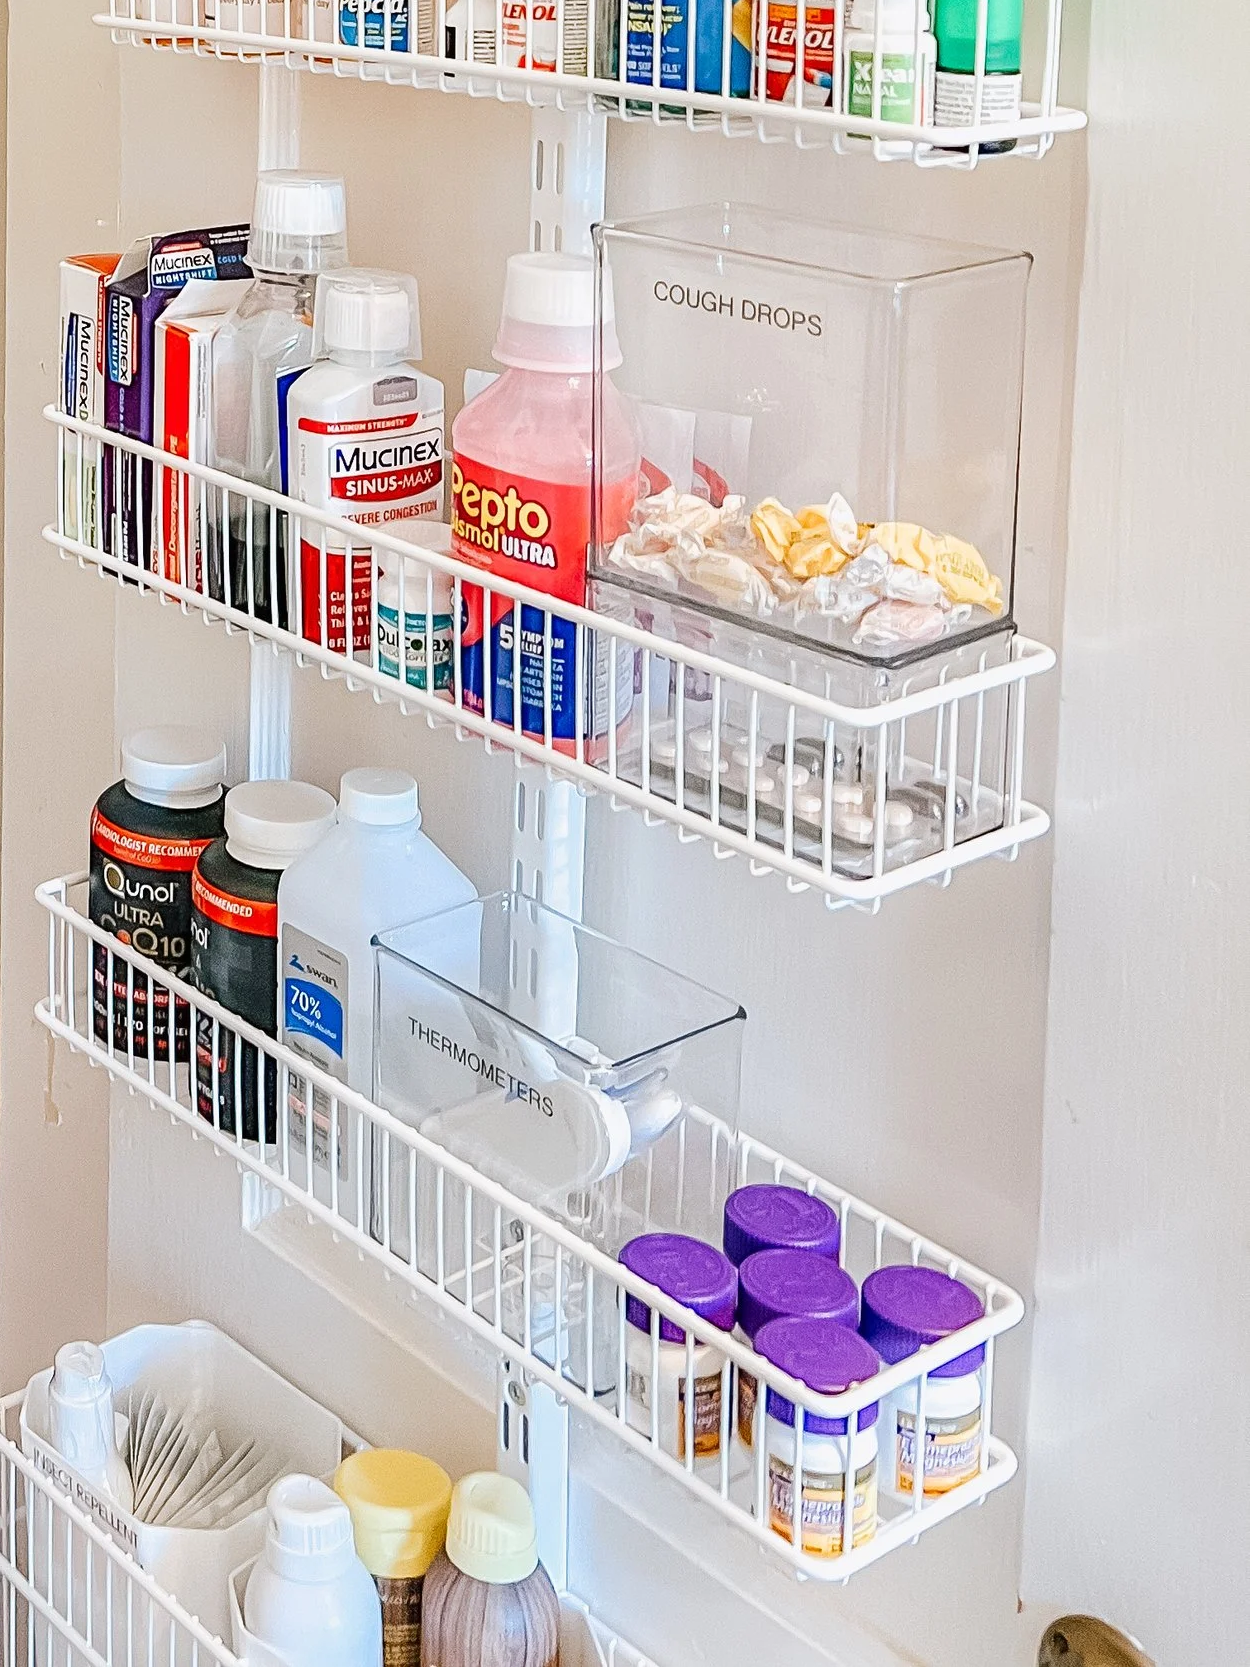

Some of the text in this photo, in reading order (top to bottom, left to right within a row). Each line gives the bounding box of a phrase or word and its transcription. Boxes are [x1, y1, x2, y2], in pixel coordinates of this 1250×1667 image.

[853, 83, 897, 97] NAAL
[154, 254, 212, 272] Mucinex
[654, 281, 822, 337] COUGH DROPS
[120, 300, 130, 381] Mucinex
[79, 320, 91, 421] Mucinex D
[327, 421, 366, 433] MAXIMUM
[335, 438, 440, 473] Mucinex
[346, 468, 434, 497] SINUS-MAX
[383, 500, 438, 522] CONGESTION
[452, 462, 549, 538] Pepto
[501, 534, 555, 568] ULTRA
[500, 623, 513, 650] 5
[96, 820, 146, 850] CARDIOLOGIST
[103, 862, 174, 903] Qunol
[114, 900, 164, 929] ULTRA
[306, 964, 337, 988] swan
[291, 985, 321, 1020] 70%
[408, 1016, 553, 1117] THERMOMETERS
[34, 1446, 137, 1548] INSECT REPELLENT
